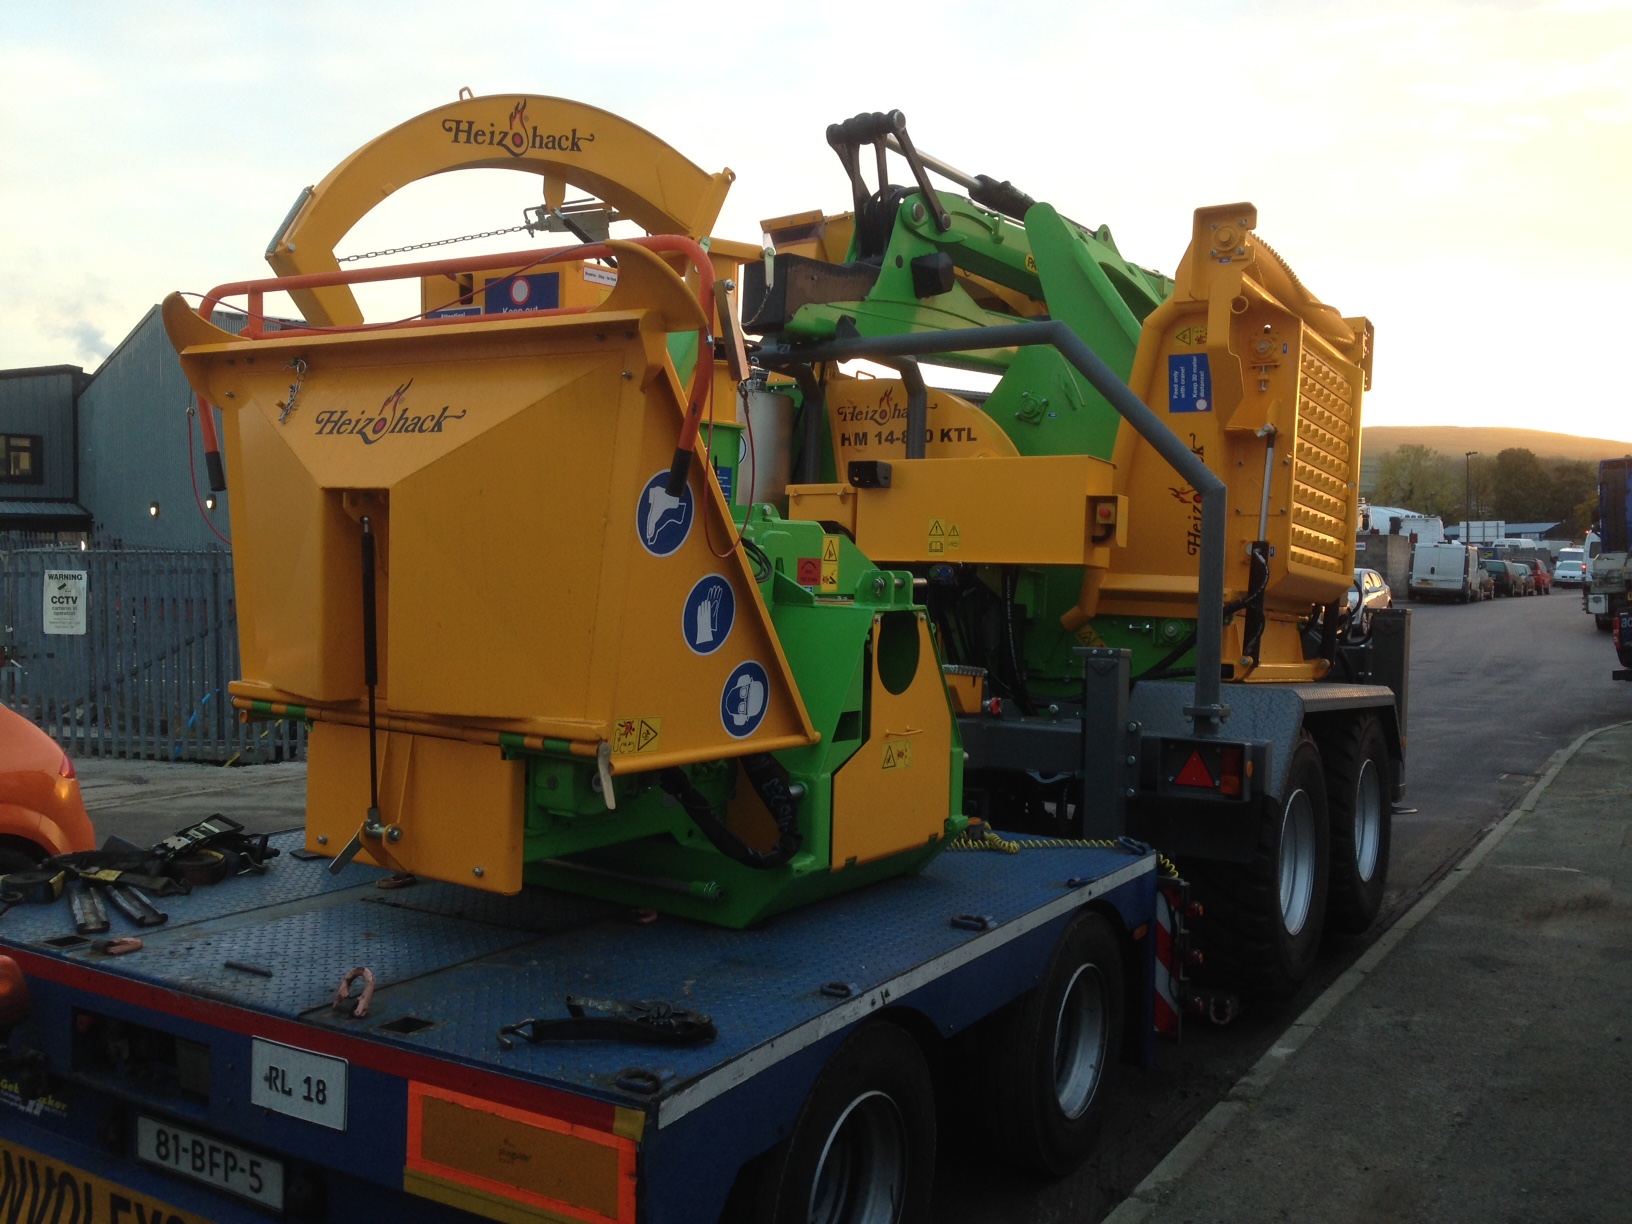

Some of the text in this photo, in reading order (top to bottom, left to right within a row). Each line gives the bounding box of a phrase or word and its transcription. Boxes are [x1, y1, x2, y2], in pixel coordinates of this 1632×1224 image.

[1192, 373, 1198, 382] 20
[841, 427, 977, 447] HM 14-80 KTL
[51, 595, 78, 605] CCTV
[268, 1065, 327, 1106] RL 18
[156, 1128, 264, 1194] 81-BFP-5
